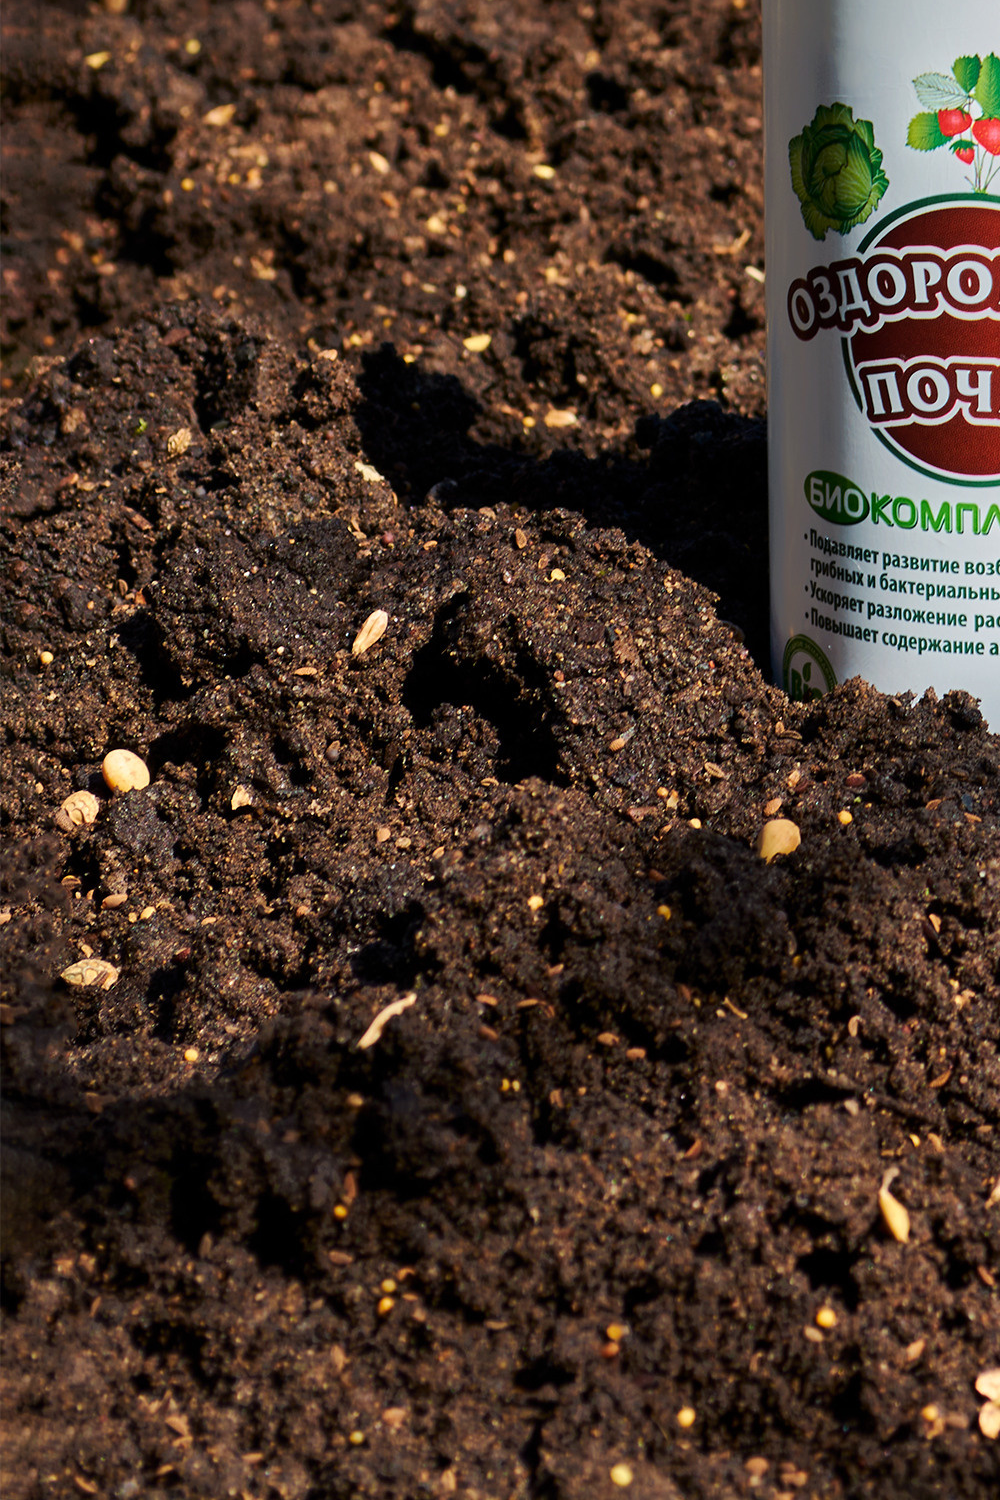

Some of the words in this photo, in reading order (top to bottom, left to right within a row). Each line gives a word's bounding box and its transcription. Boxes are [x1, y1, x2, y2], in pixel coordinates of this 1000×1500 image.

[810, 528, 879, 564] Подавляет
[882, 551, 960, 575] развитие
[810, 558, 863, 587] грибных
[867, 574, 876, 589] и
[810, 580, 864, 613] Ускоряет
[867, 602, 968, 627] разложение
[810, 607, 879, 643] Повышает
[881, 631, 985, 655] содержание
